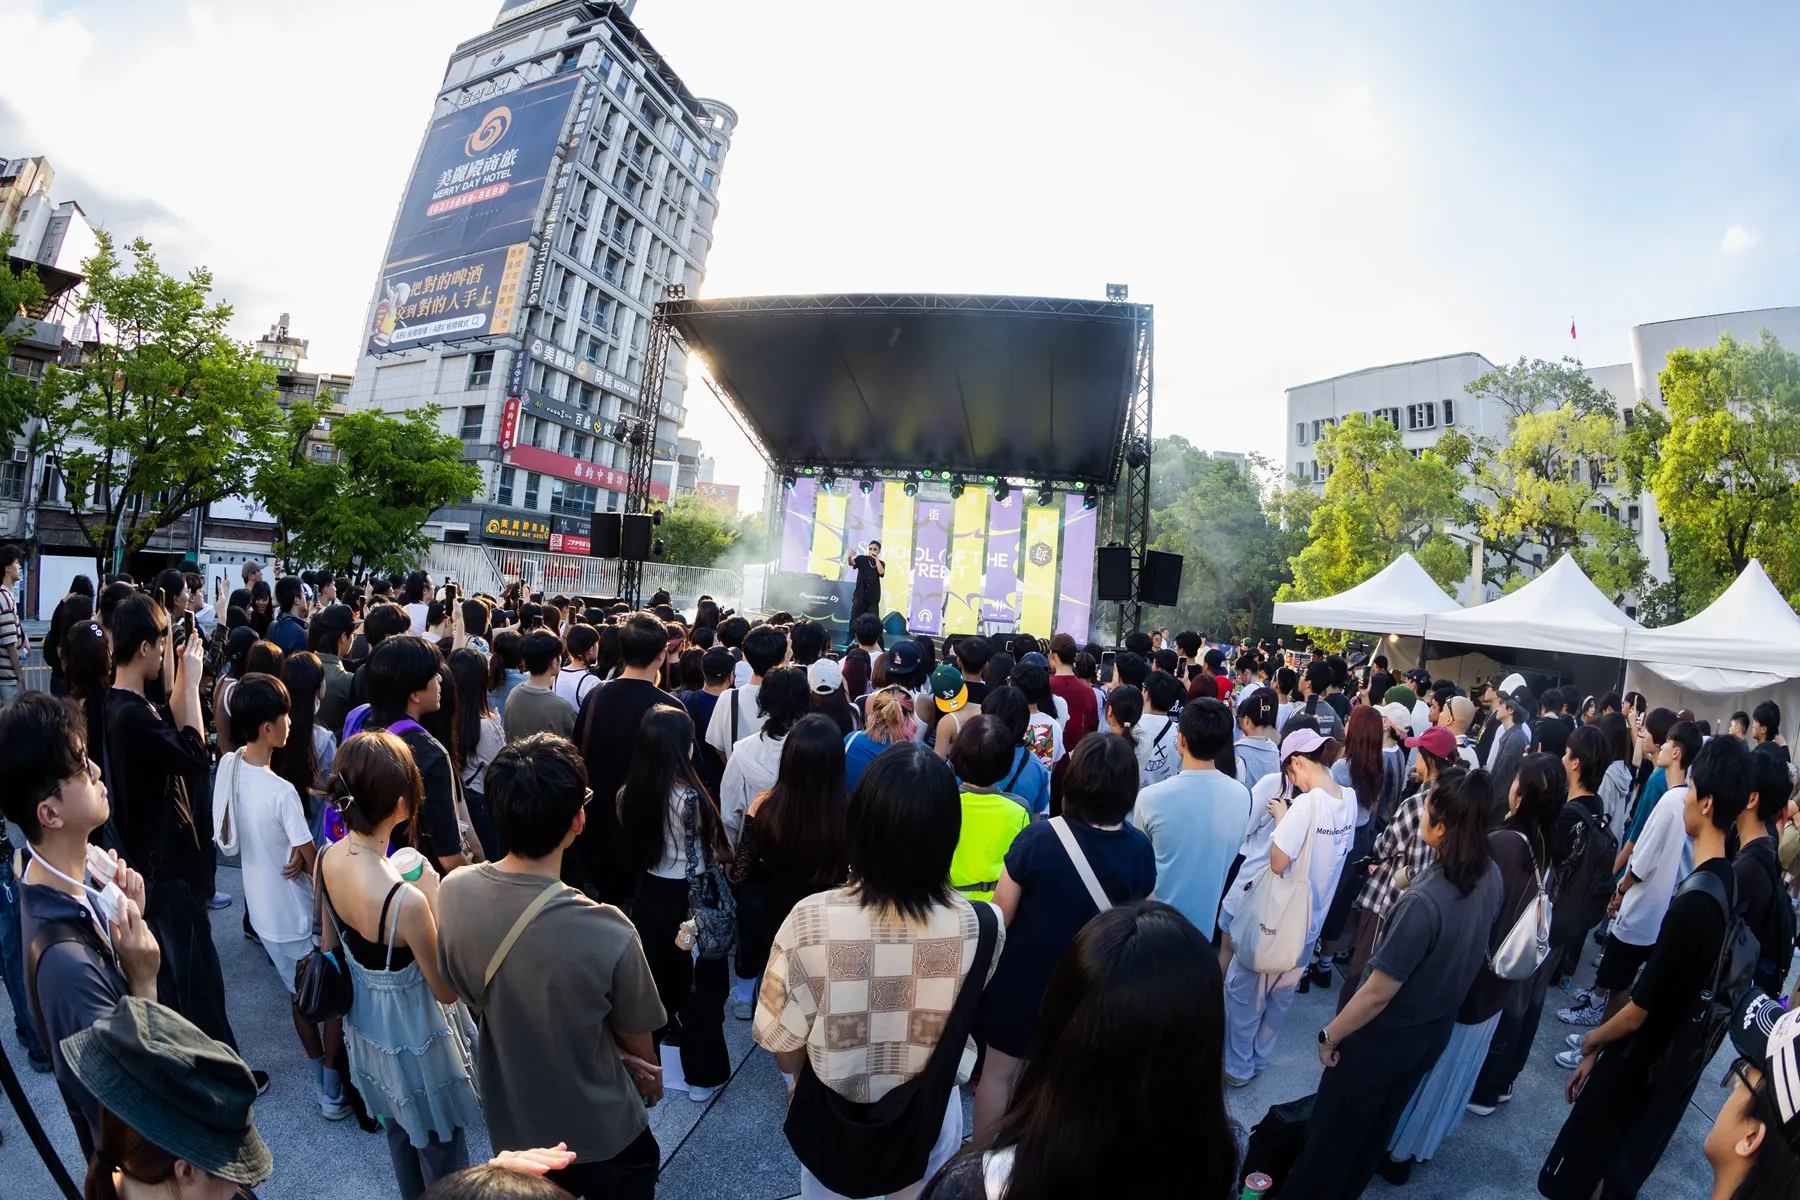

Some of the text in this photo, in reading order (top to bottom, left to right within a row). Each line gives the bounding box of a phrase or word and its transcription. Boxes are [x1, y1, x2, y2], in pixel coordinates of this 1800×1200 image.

[432, 169, 512, 200] MERRY DAY HOTEL
[435, 148, 519, 191] 美麗殿商旅
[544, 223, 556, 240] DAY
[538, 241, 551, 262] CITY
[409, 263, 485, 297] 把對的啤酒
[530, 264, 545, 294] HOTEL
[395, 285, 493, 321] 交到對的人手上
[543, 345, 640, 399] 美麗殿 商旅 MERRY DAY
[574, 462, 628, 487] 鼎鈞中醫診
[928, 508, 939, 521] 街
